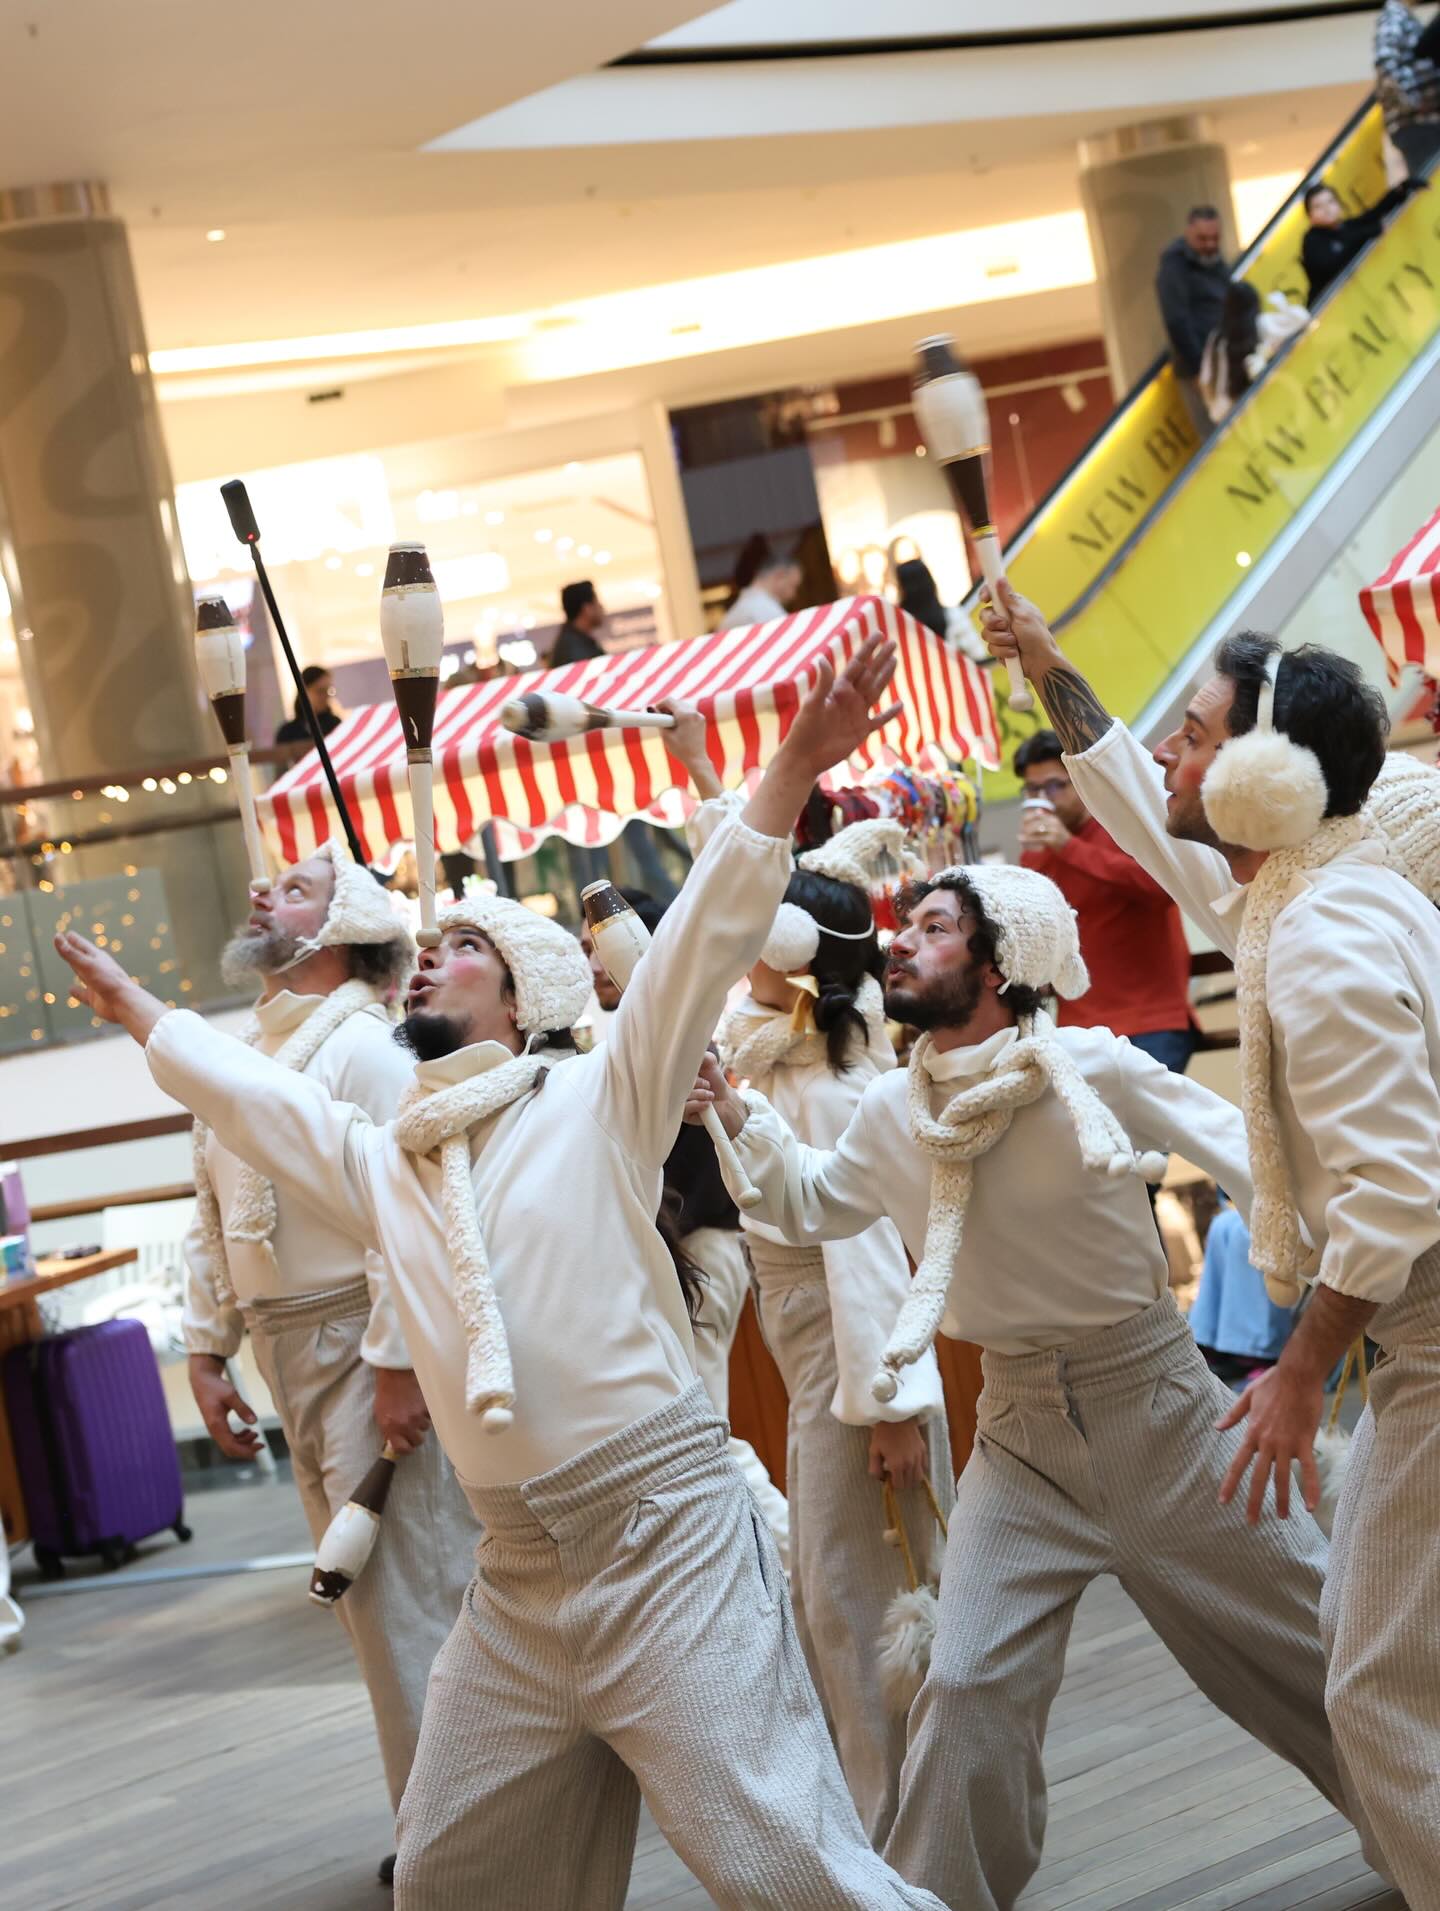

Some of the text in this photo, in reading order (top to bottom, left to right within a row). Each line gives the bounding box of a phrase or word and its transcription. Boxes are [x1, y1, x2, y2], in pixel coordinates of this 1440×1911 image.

[1226, 412, 1307, 518] NEW
[1303, 253, 1435, 423] BEAUTY
[1068, 463, 1148, 563] NEW
